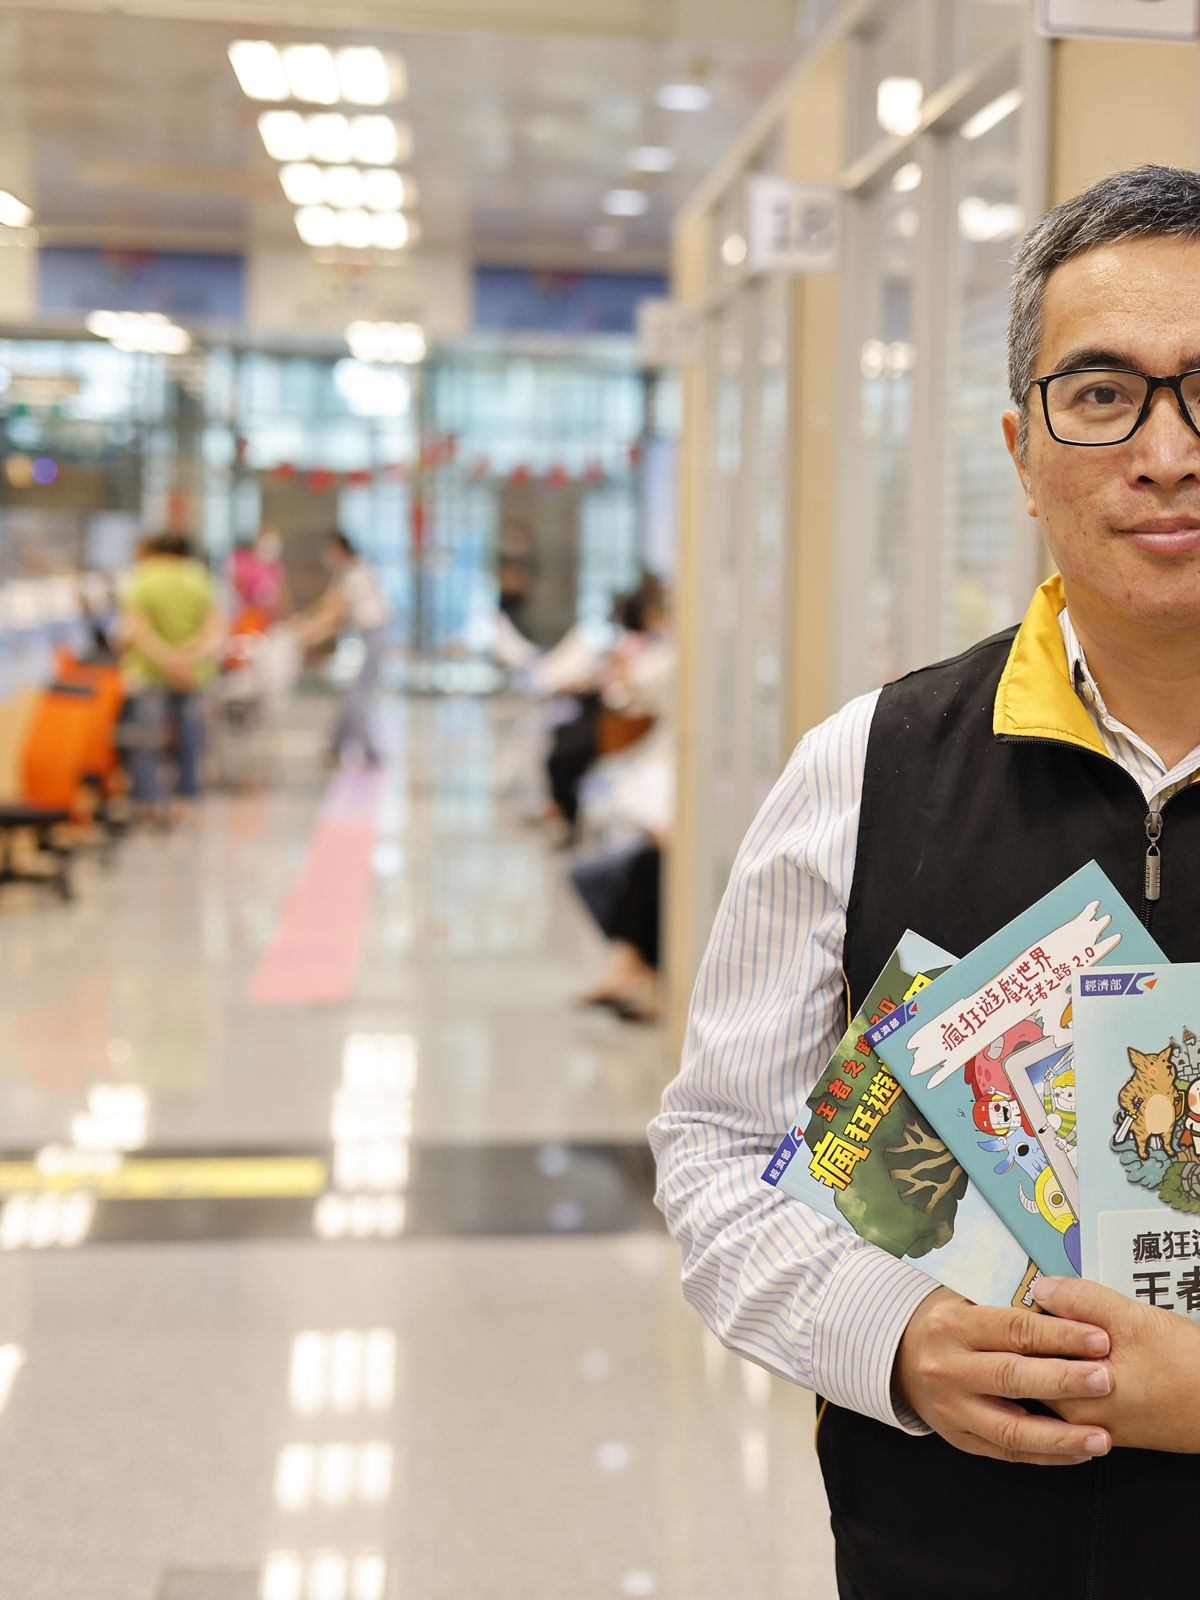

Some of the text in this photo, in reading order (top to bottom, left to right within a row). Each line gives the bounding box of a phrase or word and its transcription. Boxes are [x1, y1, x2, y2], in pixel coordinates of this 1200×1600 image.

[1024, 947, 1095, 1006] 王者之路 2.0
[1084, 979, 1122, 993] 經濟部
[942, 946, 1051, 1051] 瘋狂遊戲世界
[871, 1018, 900, 1042] 經濟部
[769, 1149, 791, 1180] 經濟部
